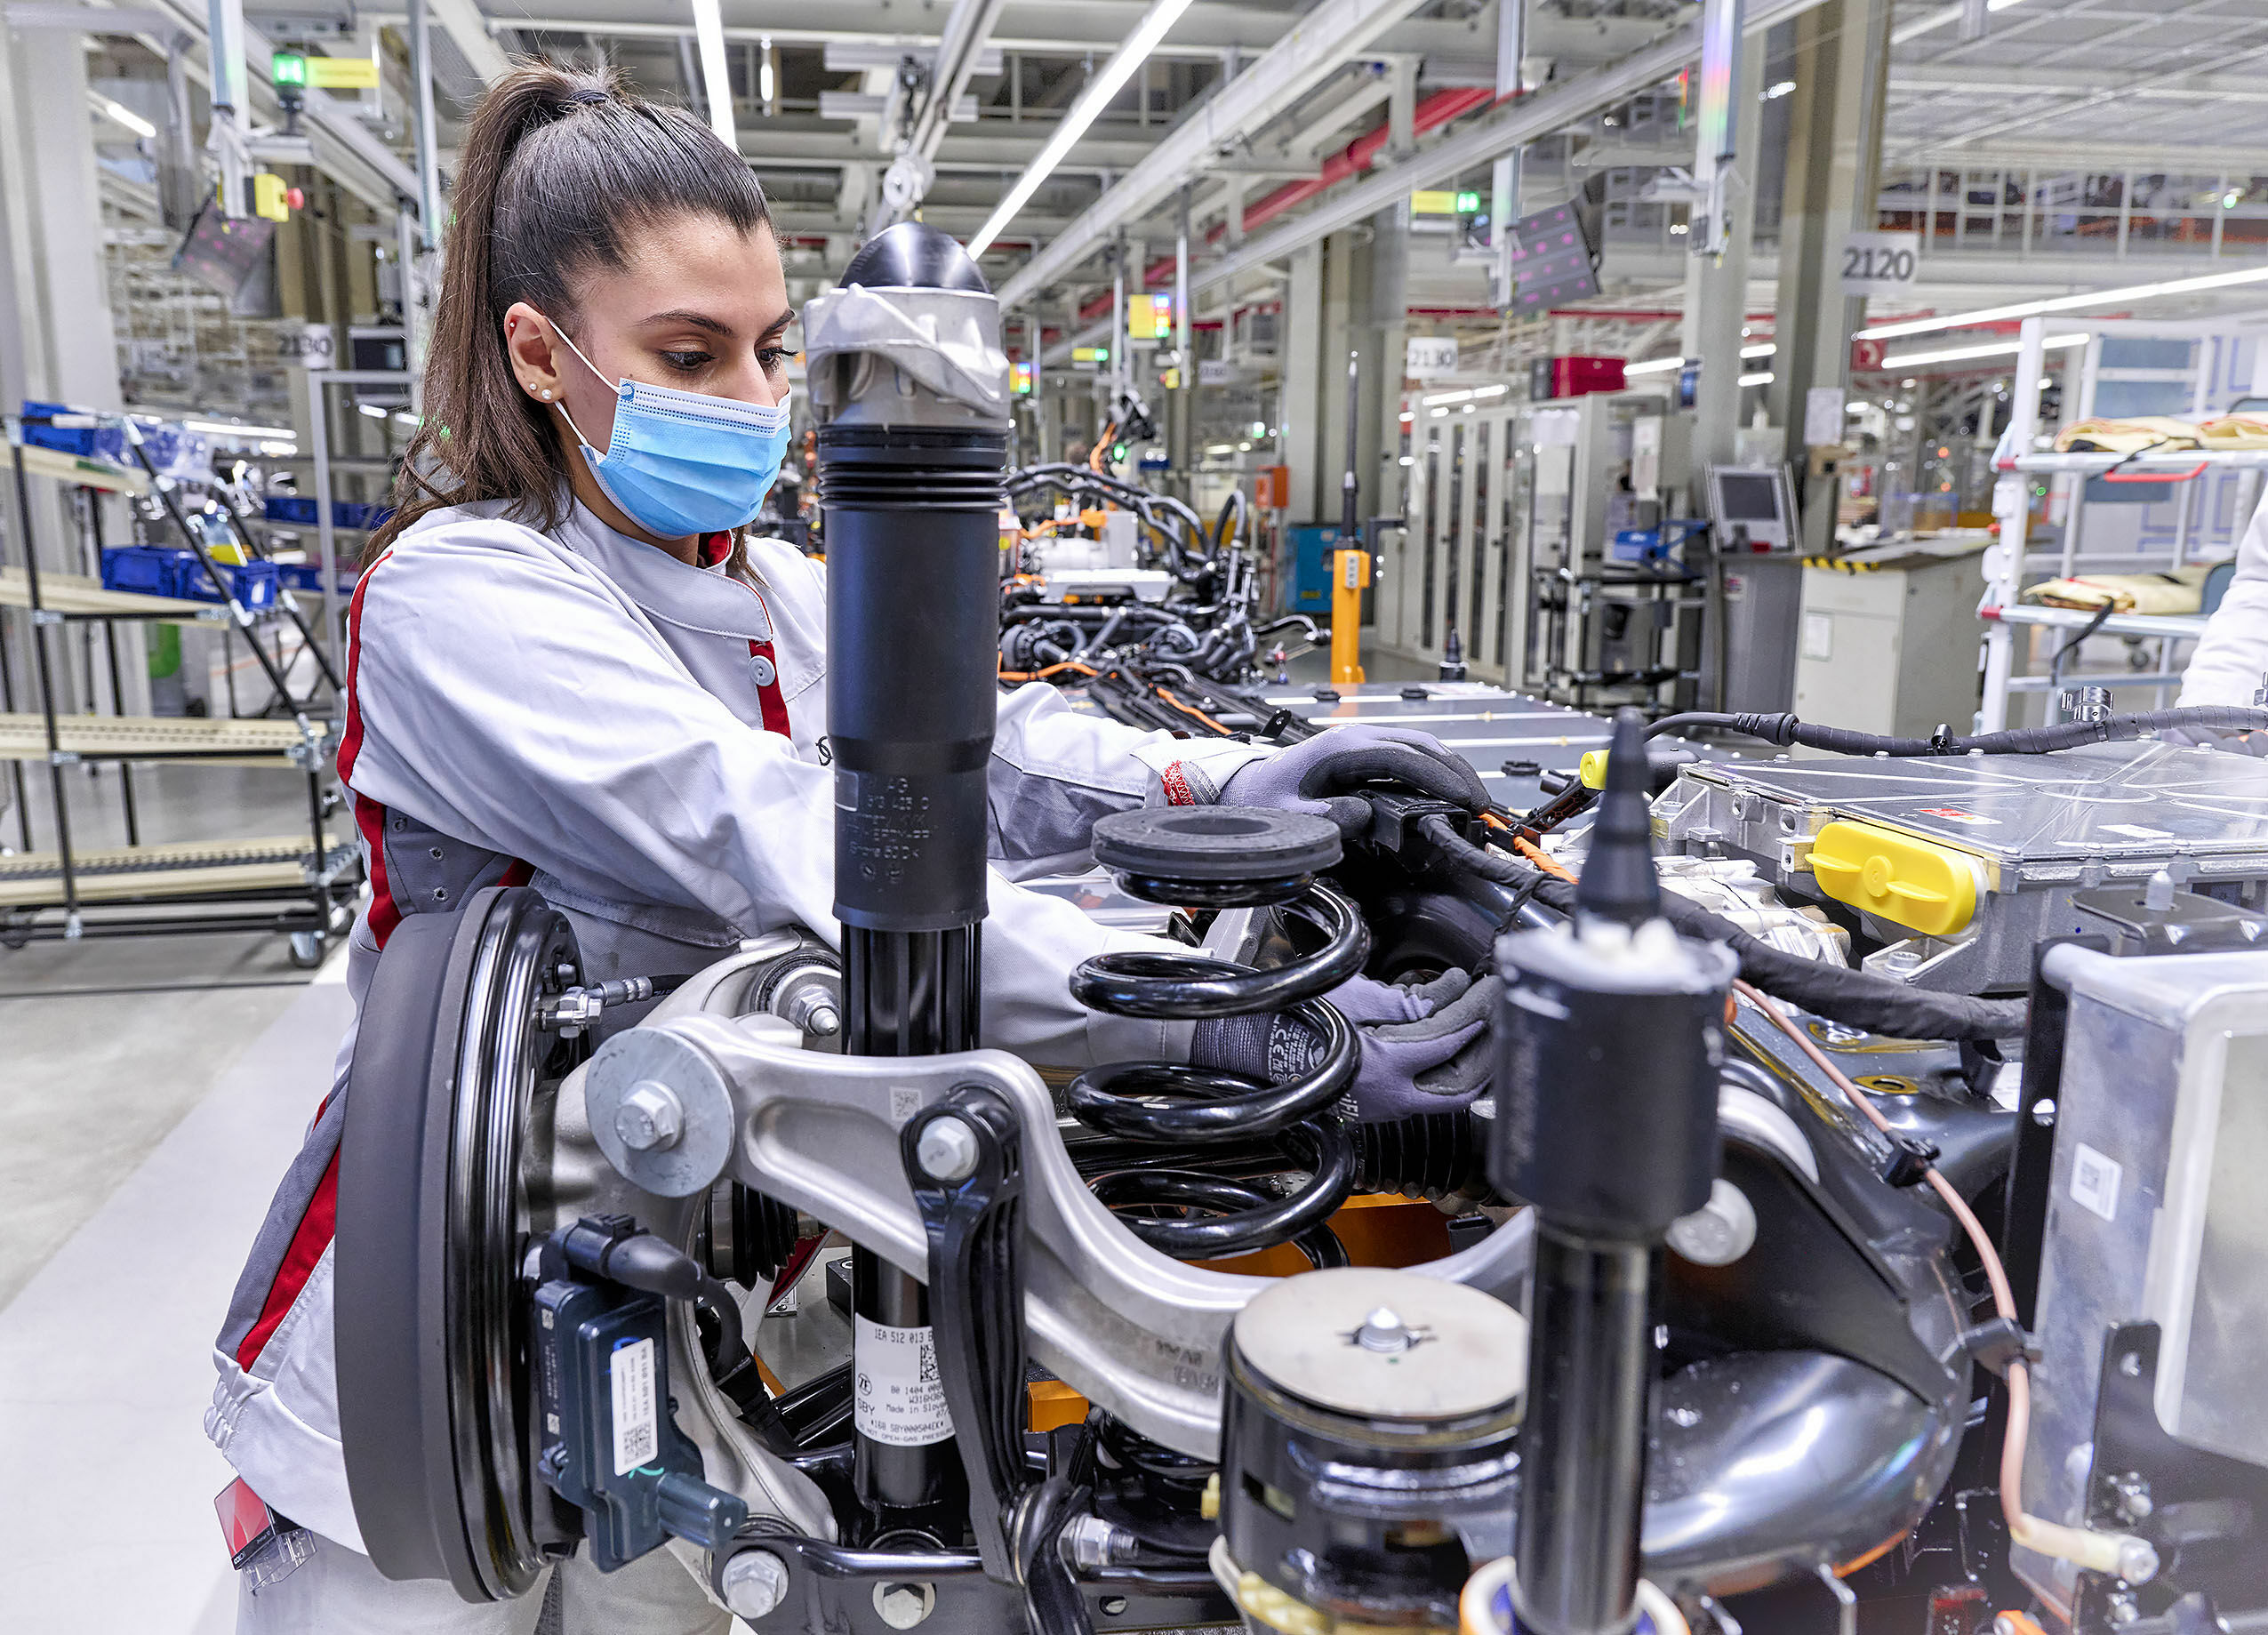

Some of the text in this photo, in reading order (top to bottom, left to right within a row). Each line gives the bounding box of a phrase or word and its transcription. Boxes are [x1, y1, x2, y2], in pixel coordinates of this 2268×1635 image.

[1843, 247, 1914, 280] 2120
[875, 1328, 887, 1341] 1EA
[891, 1333, 905, 1343] 512
[910, 1333, 924, 1343] 013
[857, 1398, 875, 1415] SBY
[886, 1405, 904, 1413] Made
[910, 1405, 918, 1414] in
